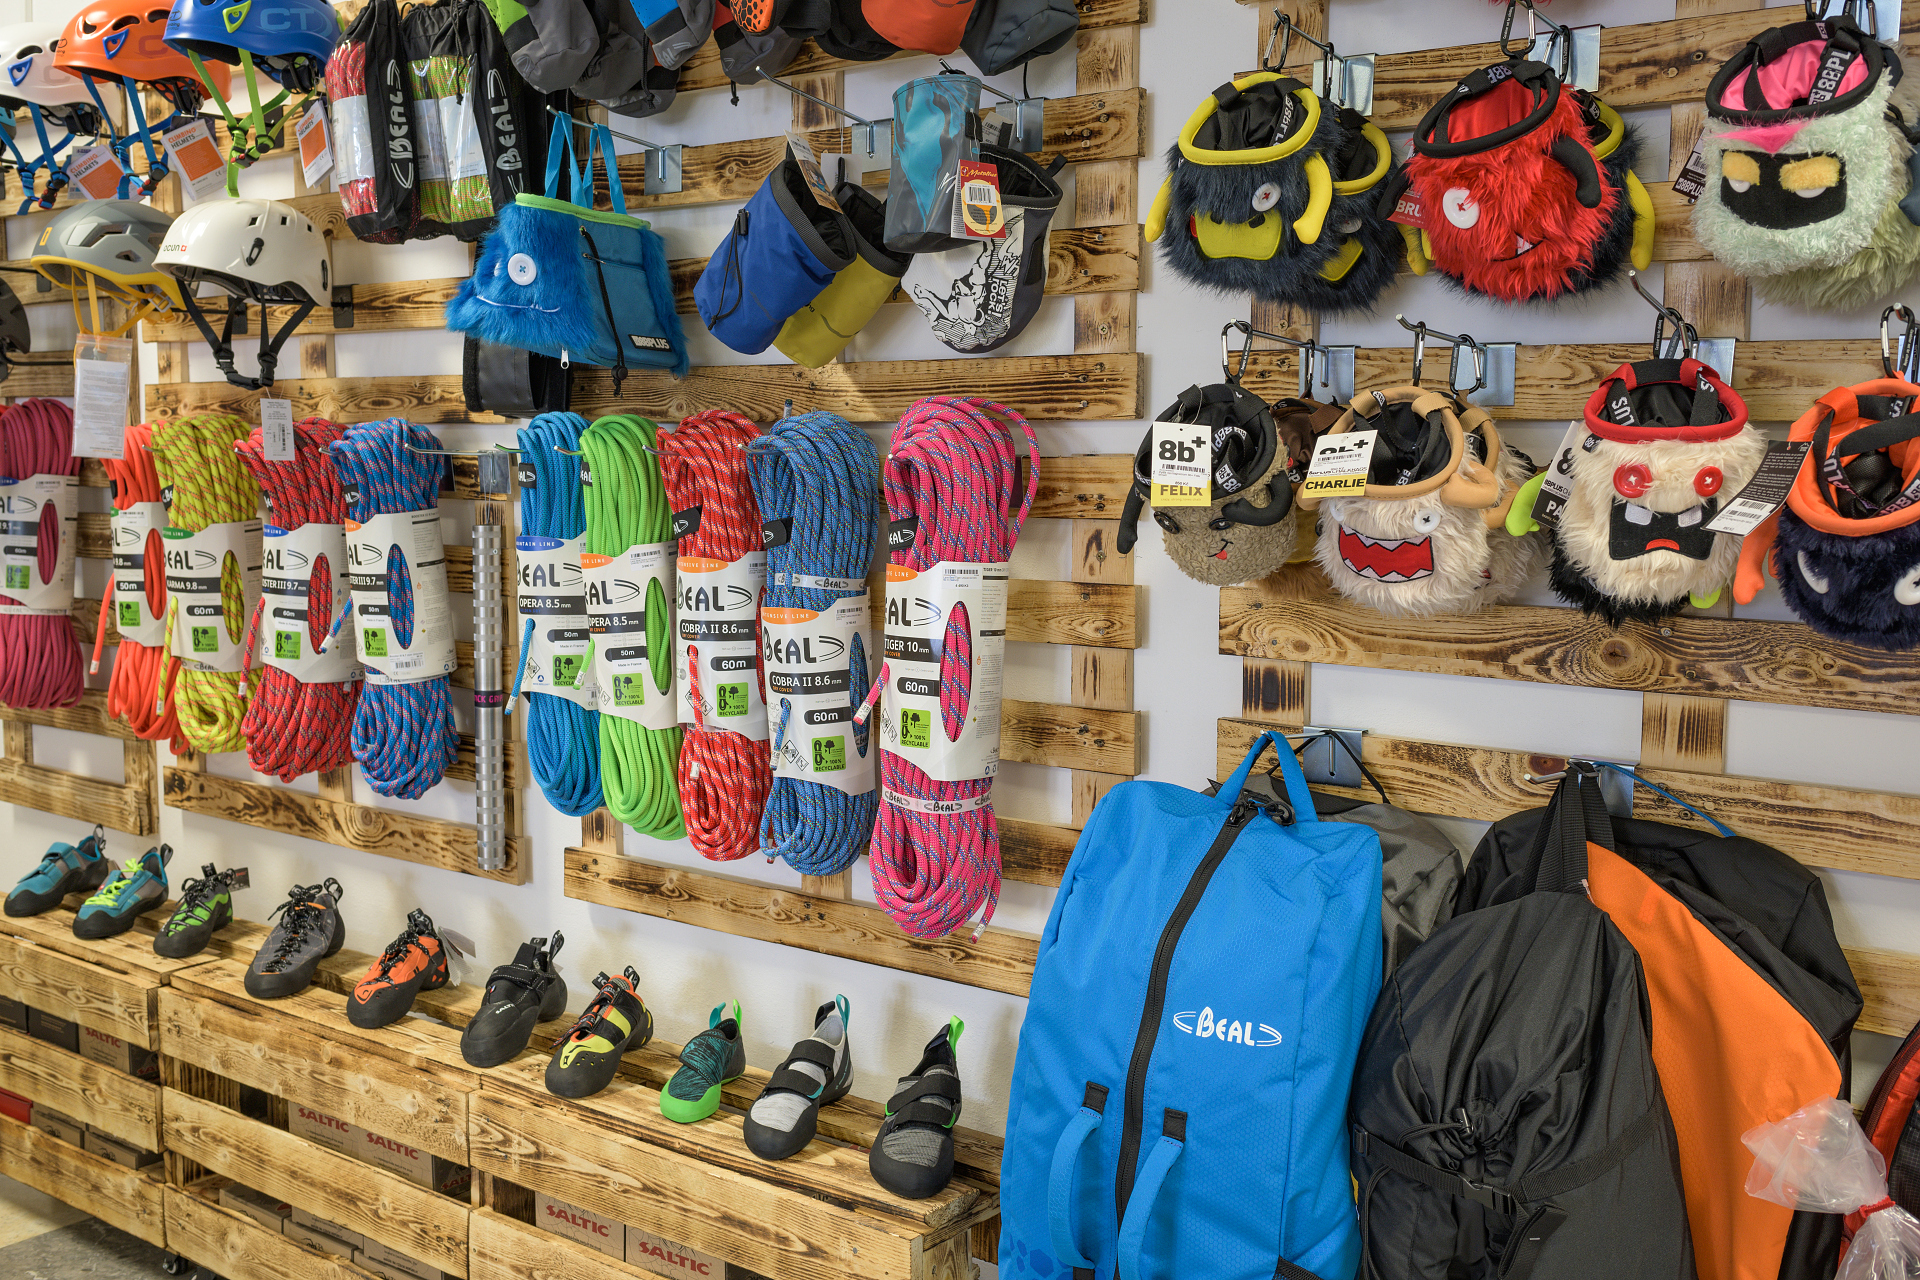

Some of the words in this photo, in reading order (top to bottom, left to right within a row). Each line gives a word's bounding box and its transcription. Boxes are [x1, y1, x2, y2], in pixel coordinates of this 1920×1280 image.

[260, 8, 314, 30] CT
[297, 113, 315, 132] CLIMBING
[299, 120, 314, 136] HELMETS
[168, 126, 197, 144] CLIMBING
[171, 134, 196, 149] HELMETS
[70, 153, 98, 174] CLIMBING
[74, 160, 99, 178] HELMETS
[1158, 436, 1206, 463] 8b+
[1160, 484, 1203, 496] FELIX
[1305, 479, 1366, 490] CHARLIE
[120, 582, 137, 590] 50m
[167, 580, 185, 590] KARMA
[287, 581, 298, 590] 9.7
[366, 577, 376, 585] 9.7
[823, 578, 842, 589] BEAL
[678, 576, 724, 611] BEAL
[520, 598, 544, 608] OPERA
[546, 599, 560, 608] 8.5
[589, 617, 611, 627] OPERA
[613, 616, 628, 626] 8.5
[682, 622, 708, 634] COBRA
[711, 624, 719, 634] II
[722, 624, 738, 634] 8.6
[763, 626, 817, 665] BEAL
[885, 640, 904, 652] TIGER
[907, 641, 918, 652] 10
[722, 659, 746, 670] 60m
[773, 674, 800, 687] COBRA
[803, 676, 812, 687] II
[815, 675, 831, 686] 8.6
[905, 681, 928, 694] 60m
[814, 711, 839, 723] 60m
[934, 801, 955, 812] BEAL
[85, 1027, 121, 1048] SALTIC
[298, 1107, 349, 1133] SALTIC
[366, 1132, 419, 1160] SALTIC
[546, 1204, 610, 1237] SALTIC
[639, 1241, 710, 1276] SALTIC
